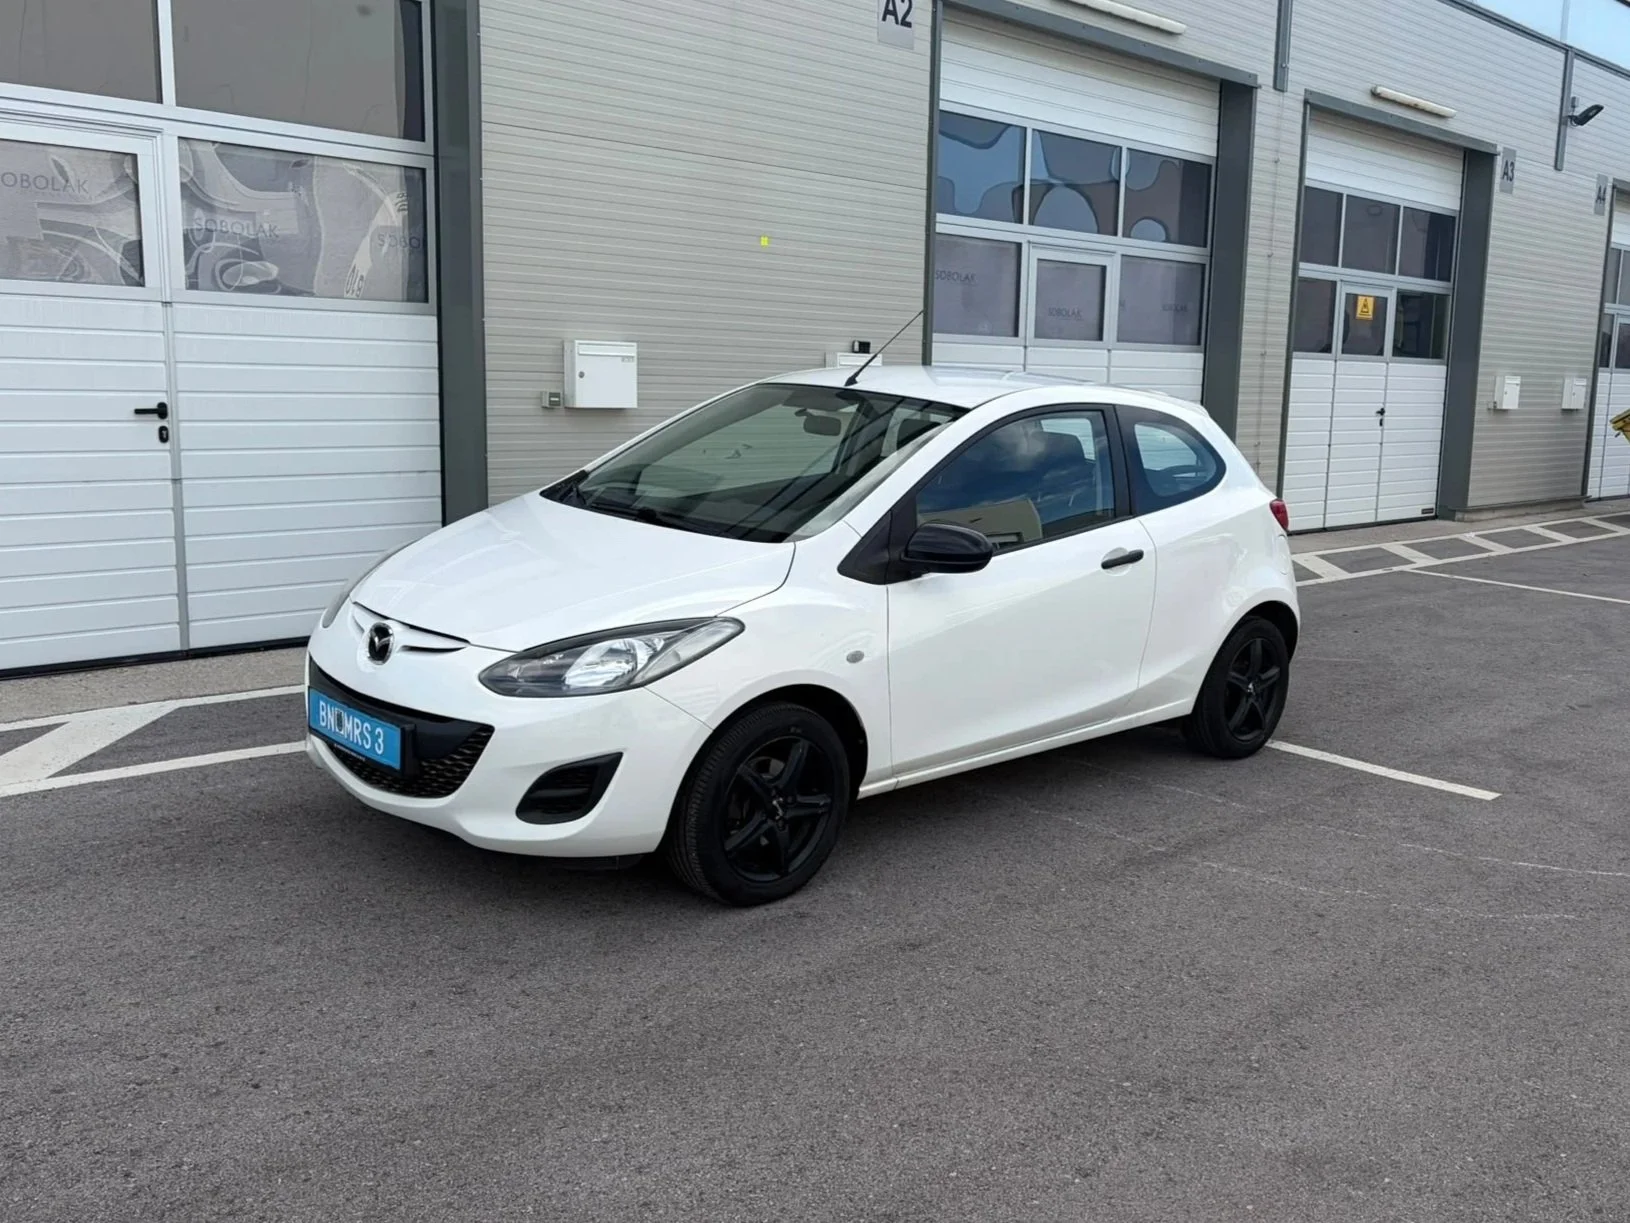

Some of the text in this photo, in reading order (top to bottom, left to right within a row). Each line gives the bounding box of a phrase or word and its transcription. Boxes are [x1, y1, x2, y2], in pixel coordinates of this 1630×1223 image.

[881, 0, 913, 28] A2
[1502, 159, 1515, 182] A3
[1595, 184, 1607, 205] A4
[319, 700, 385, 755] BN MRS 3
